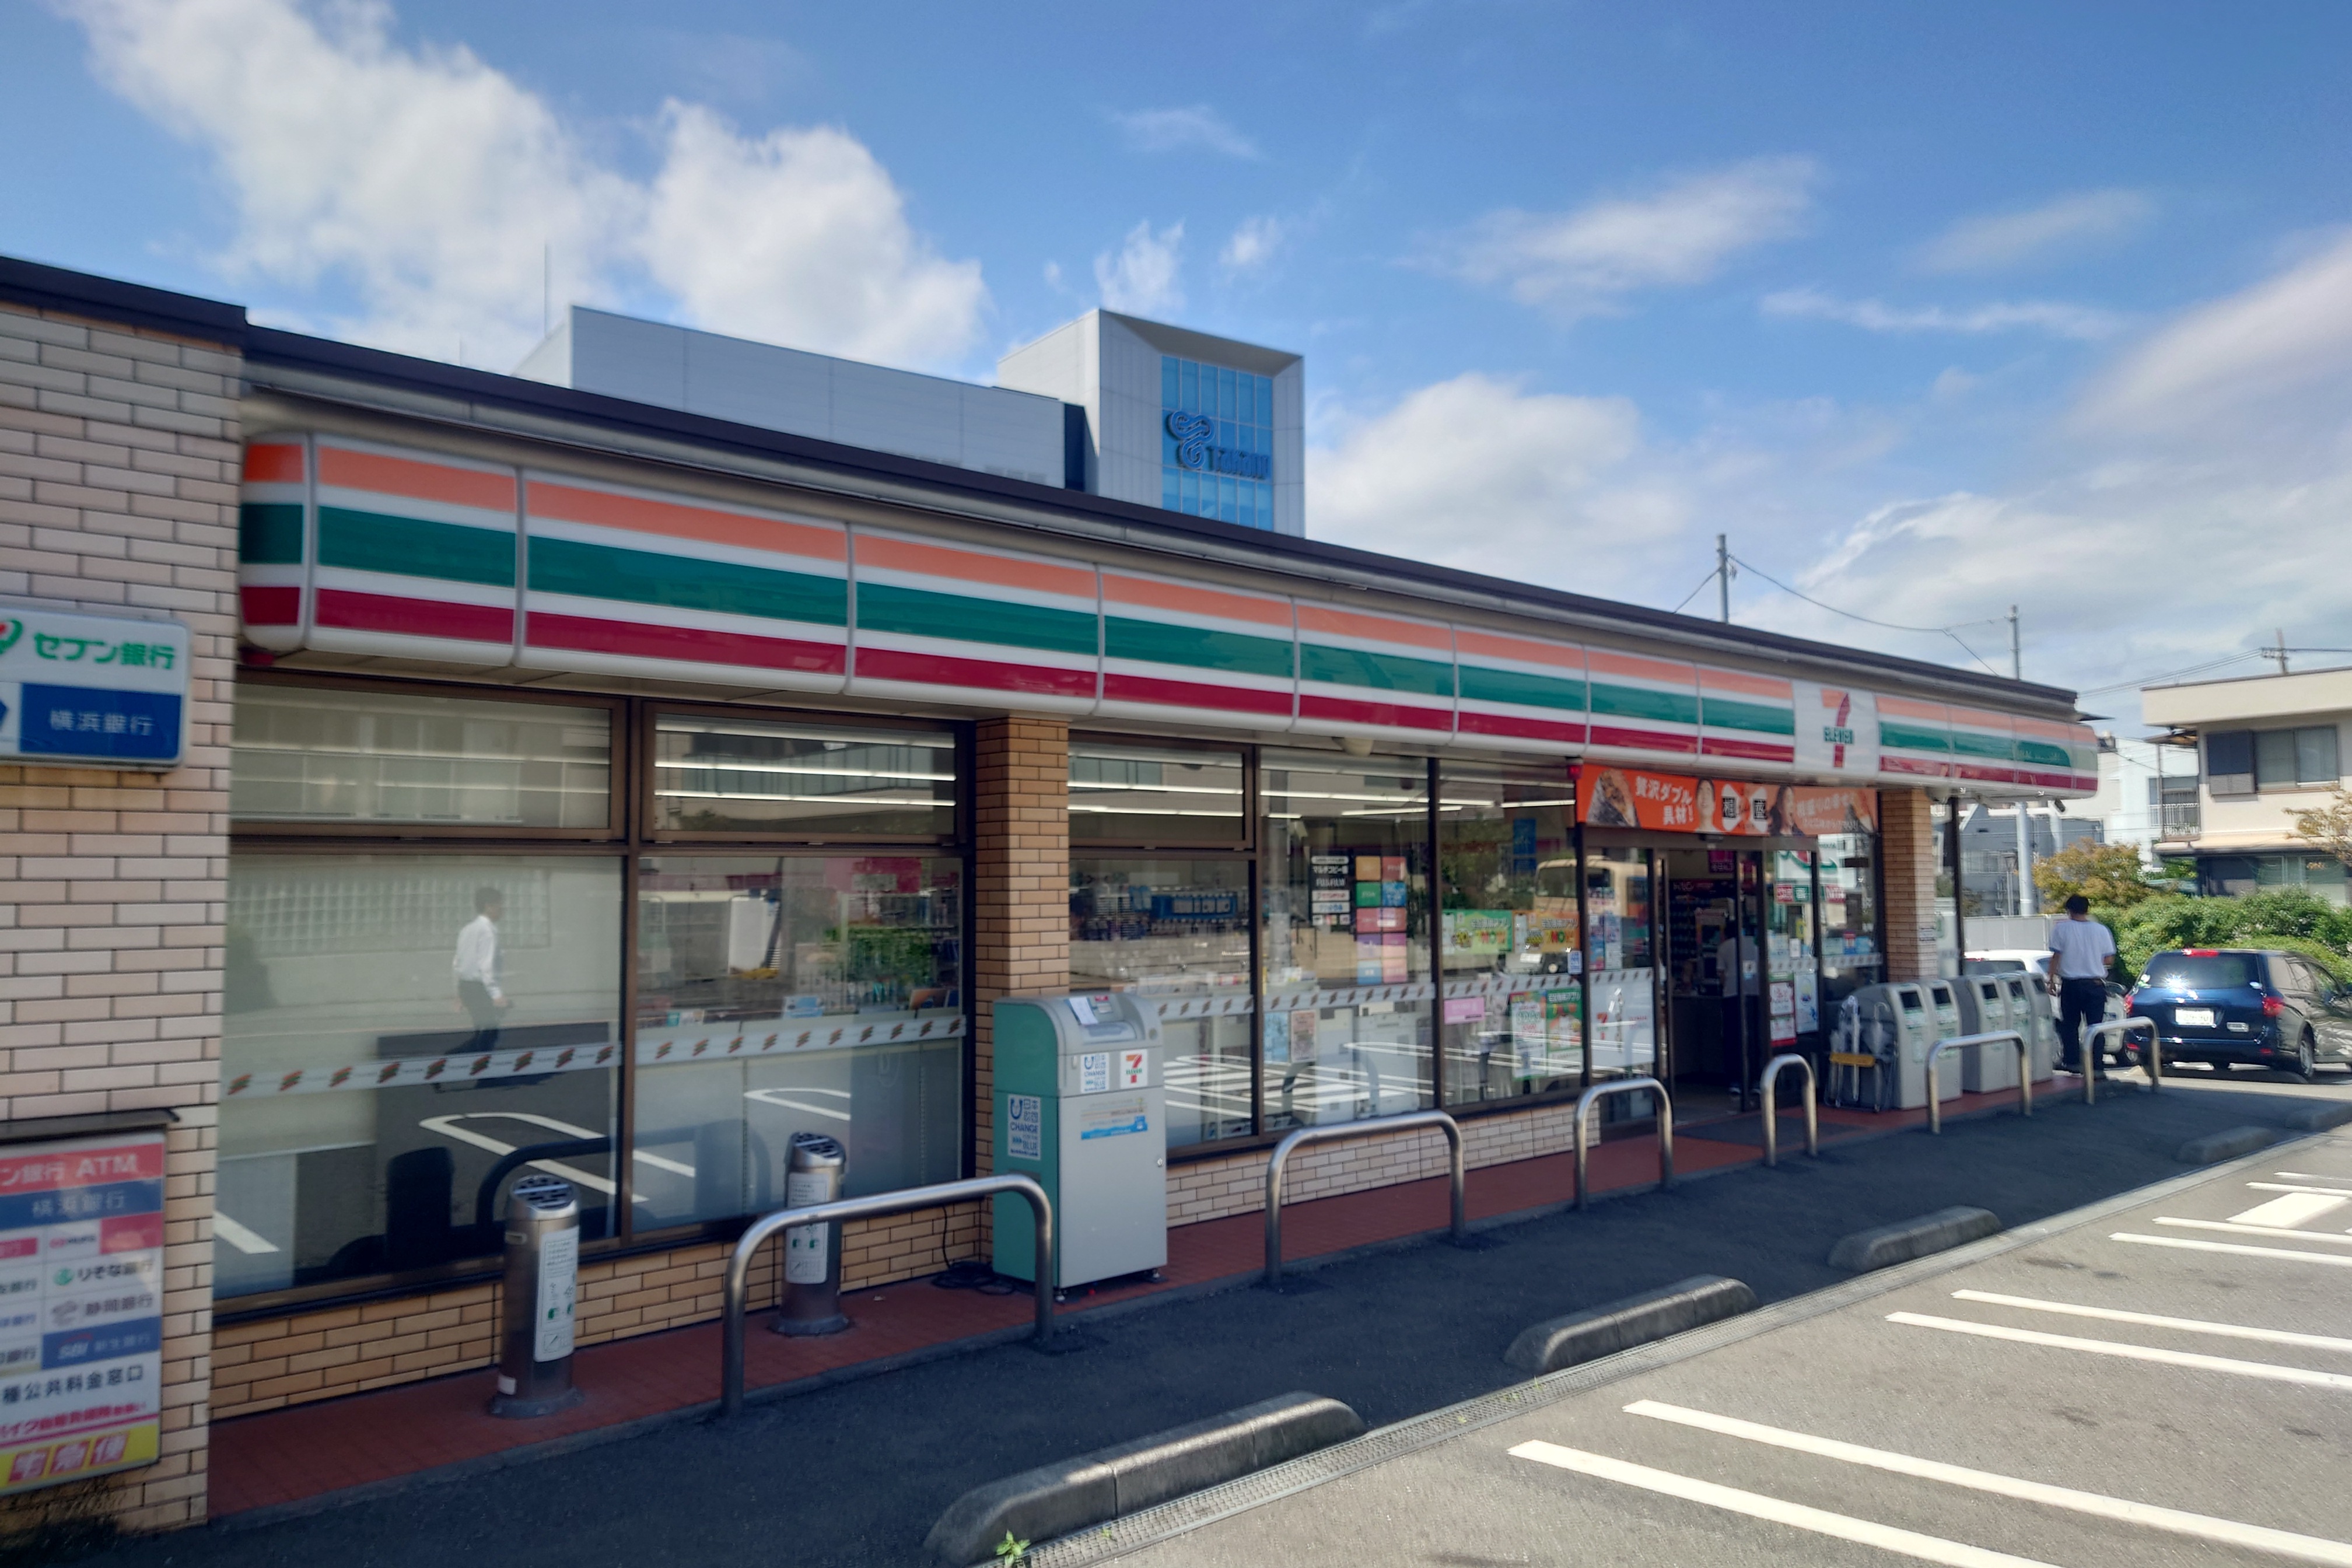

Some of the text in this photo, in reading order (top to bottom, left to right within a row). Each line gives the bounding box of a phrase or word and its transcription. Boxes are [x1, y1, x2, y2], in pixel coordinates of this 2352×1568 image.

[34, 632, 174, 669] セブン銀行
[50, 709, 155, 736] 横浜銀行
[1821, 688, 1850, 768] 7
[1636, 775, 1693, 805] 贅沢ダブル
[1664, 804, 1694, 825] 具材!
[1010, 1121, 1038, 1133] CHANGE
[76, 1153, 138, 1178] ATM
